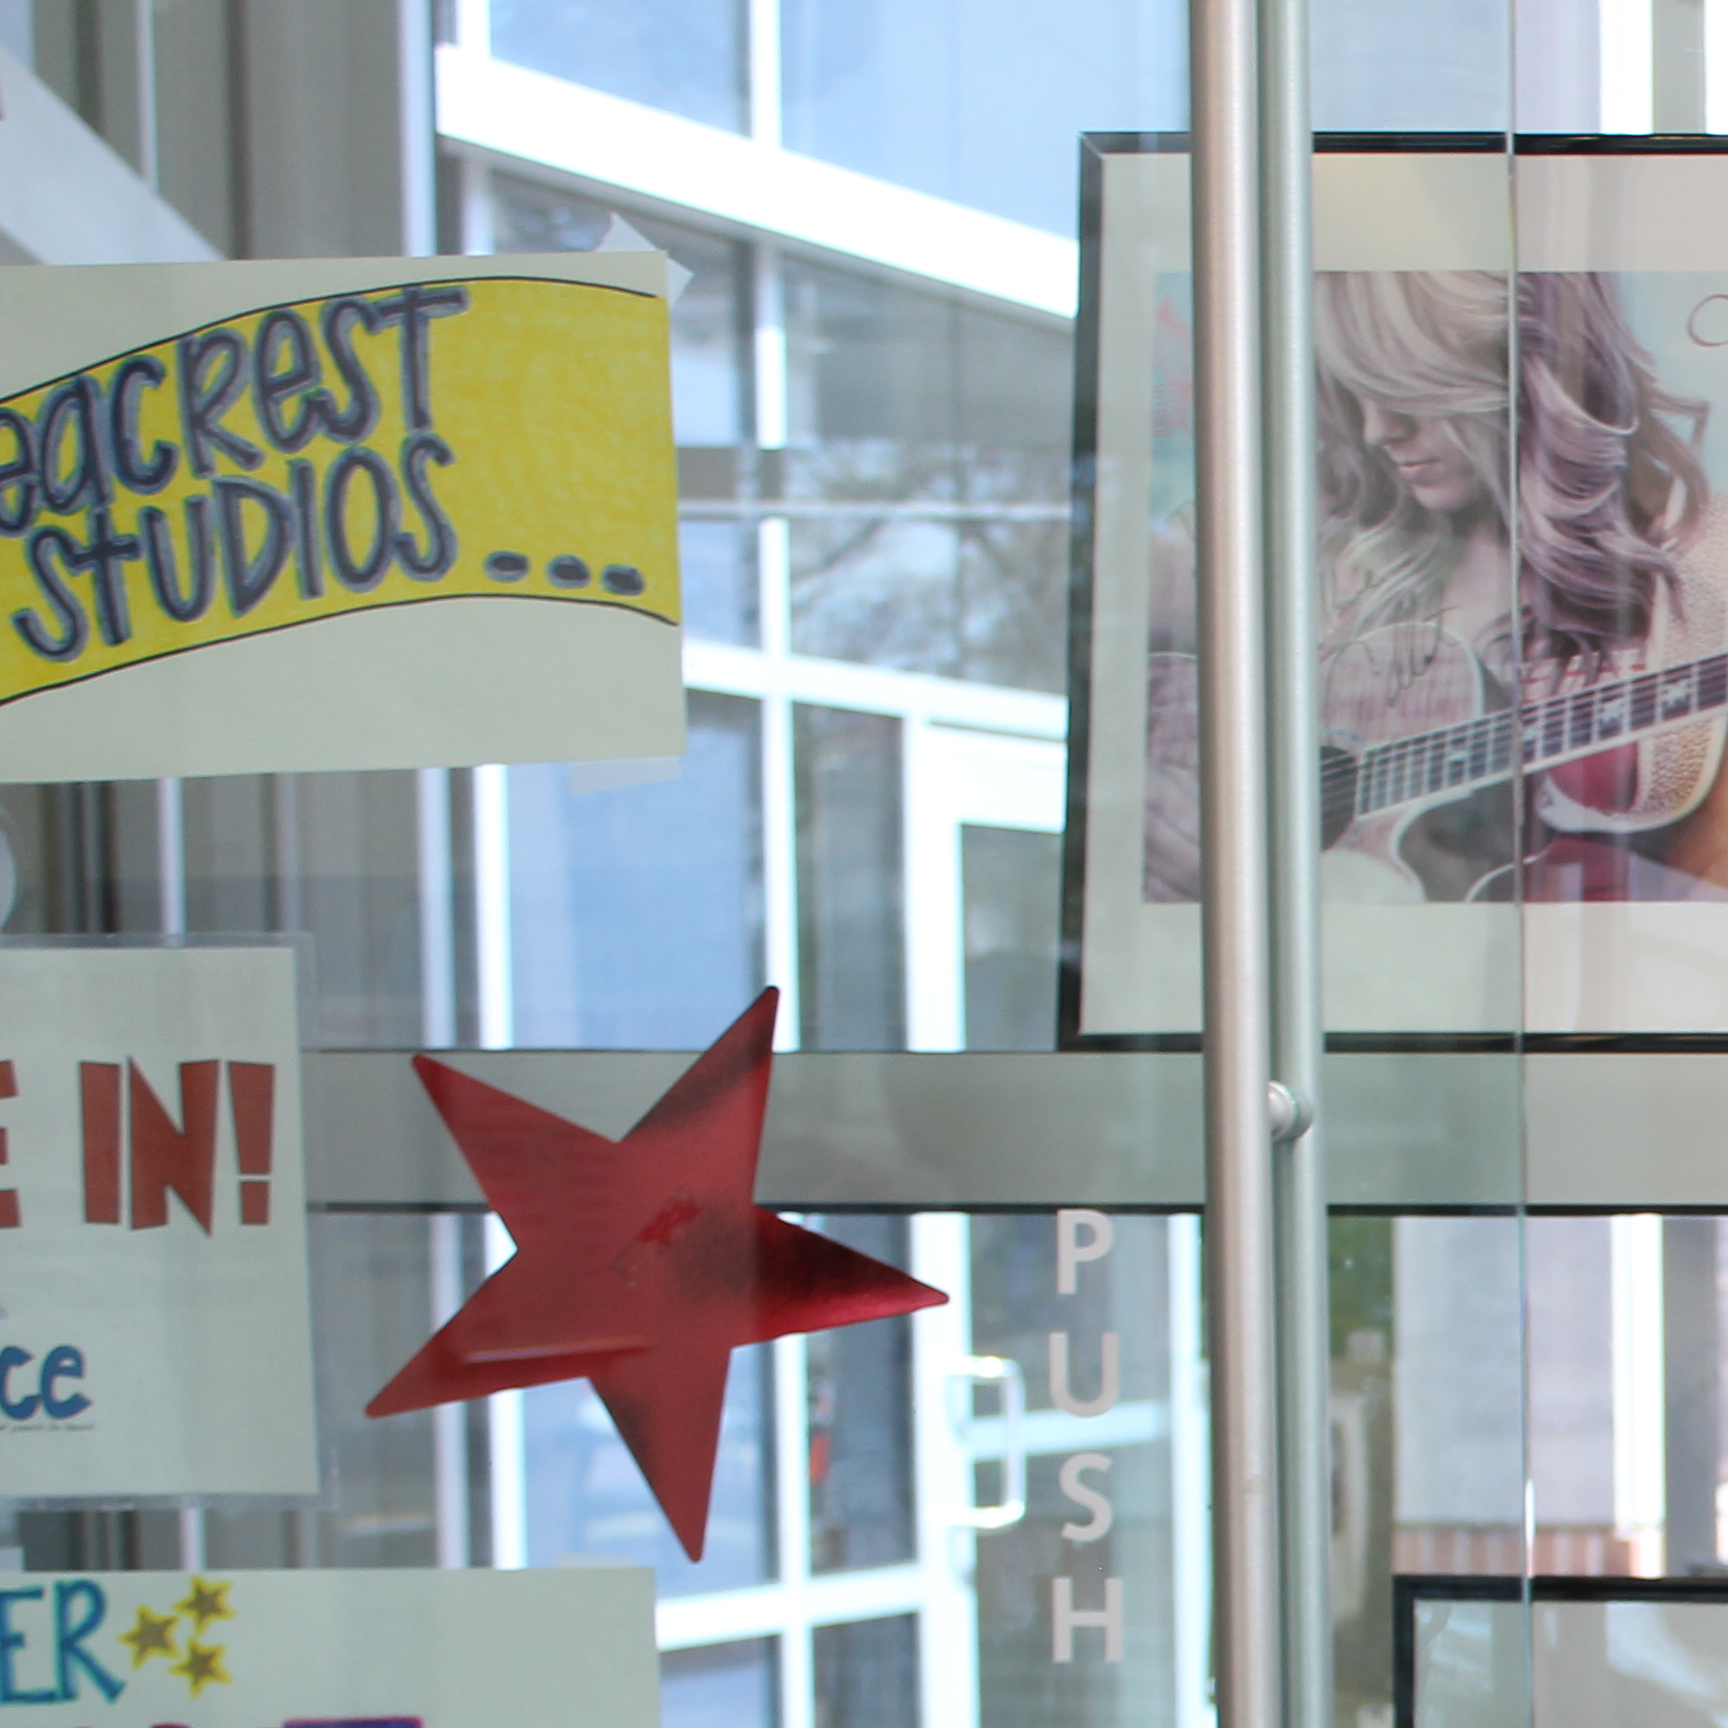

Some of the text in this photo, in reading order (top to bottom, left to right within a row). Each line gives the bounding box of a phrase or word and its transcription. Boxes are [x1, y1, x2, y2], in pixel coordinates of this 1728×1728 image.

[80, 1056, 275, 1237] IN!
[1048, 1209, 1124, 1664] PUSH
[0, 1579, 127, 1706] ER
